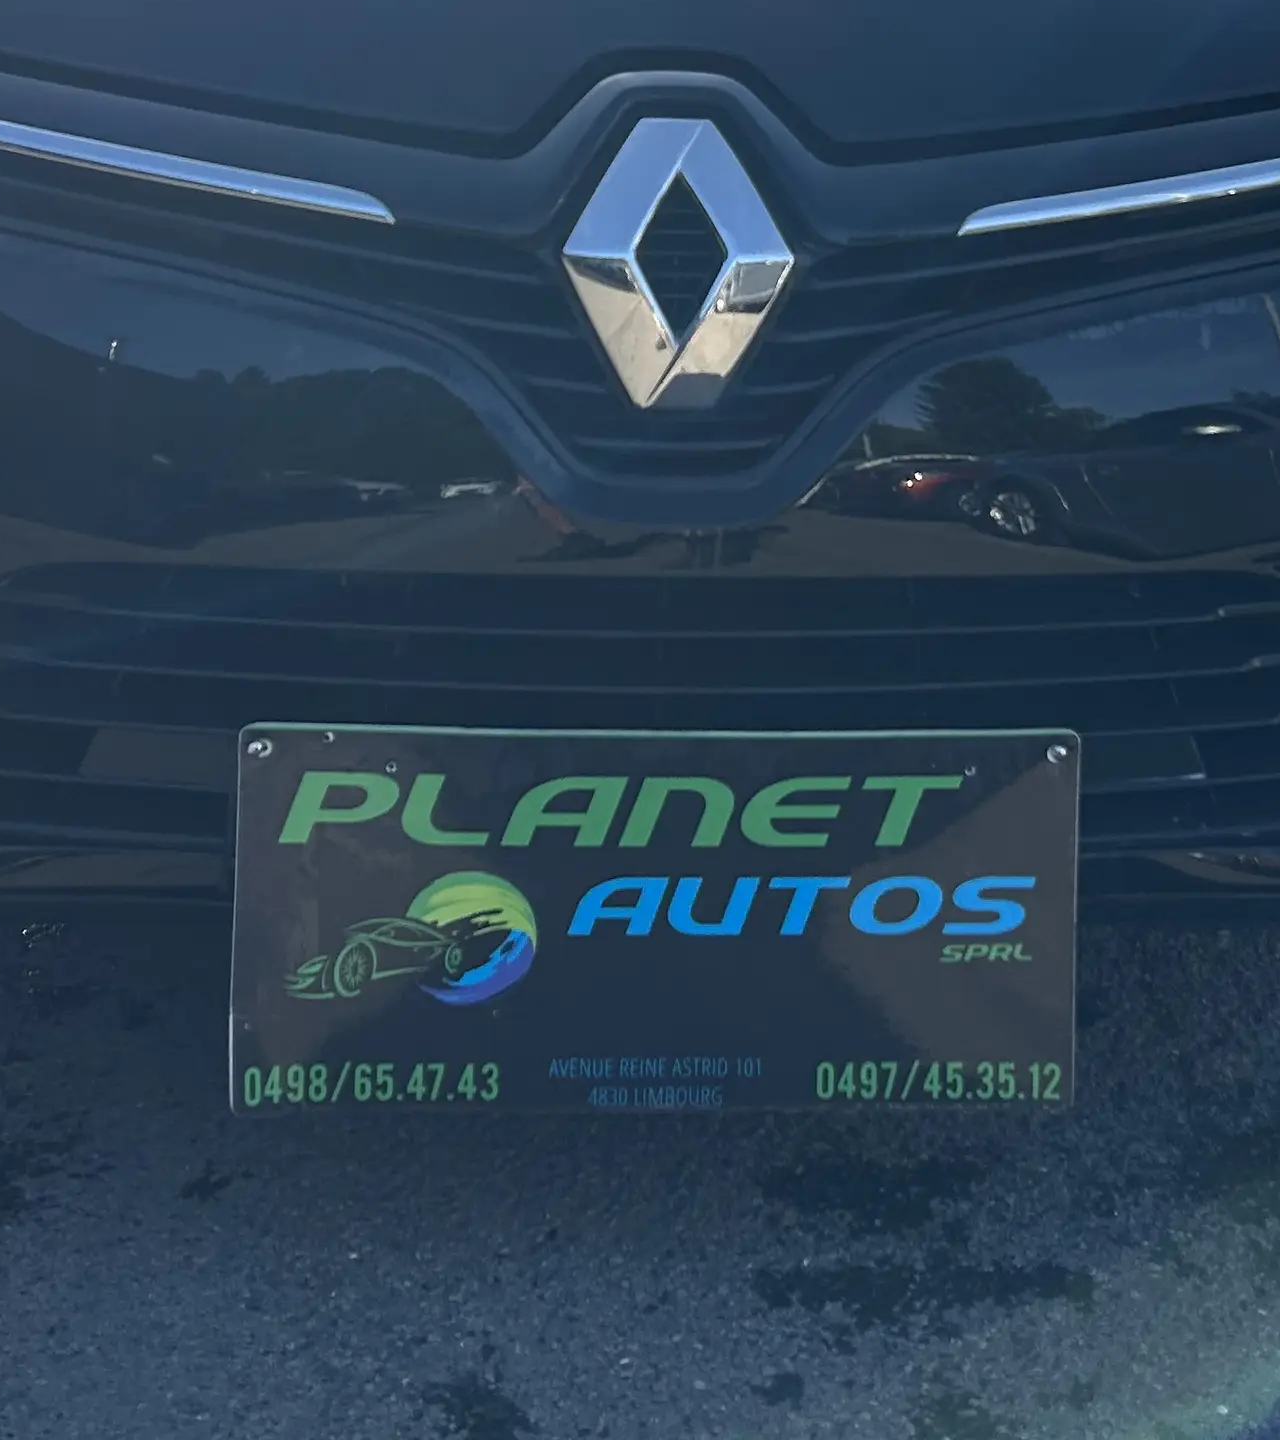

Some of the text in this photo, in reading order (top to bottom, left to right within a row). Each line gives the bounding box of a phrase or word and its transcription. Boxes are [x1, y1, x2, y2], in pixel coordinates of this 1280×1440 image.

[278, 770, 963, 847] PLANET
[567, 875, 1036, 936] AUTOS
[939, 941, 1033, 963] SPRL
[243, 1061, 500, 1108] 0498/65.47.43
[548, 1056, 763, 1078] AVENUE REINE ASTRID 101
[815, 1058, 1062, 1101] 0497/45.35.12
[587, 1085, 724, 1108] 4830 LIMBOURG
